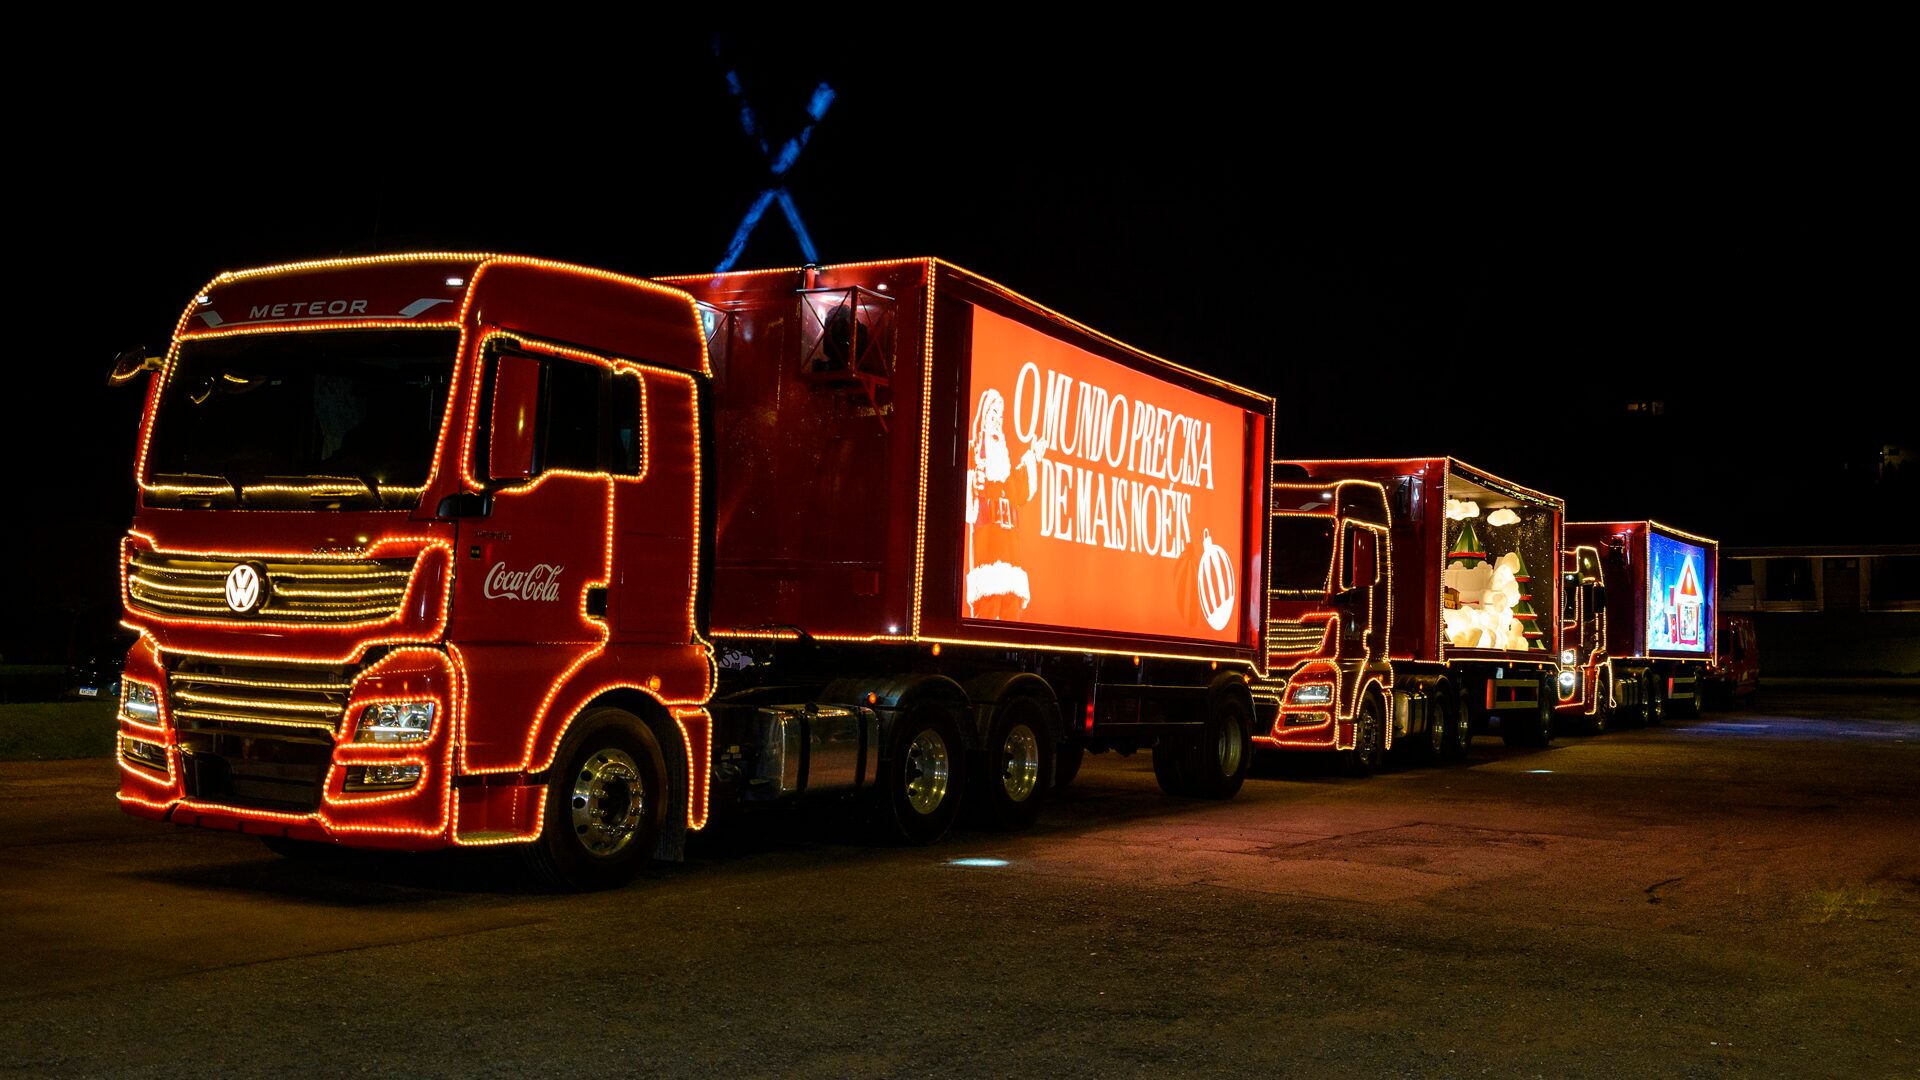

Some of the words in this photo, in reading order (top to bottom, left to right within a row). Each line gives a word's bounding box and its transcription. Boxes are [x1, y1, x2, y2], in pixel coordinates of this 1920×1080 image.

[250, 300, 368, 319] METEOR
[1014, 362, 1041, 443] O
[1042, 369, 1129, 468] MUNDO
[1127, 399, 1214, 490] PRECISA
[1040, 458, 1073, 541] DE
[1076, 467, 1128, 551] MAIS
[1130, 481, 1191, 559] NOÉIS
[483, 561, 564, 601] Coca-Cola
